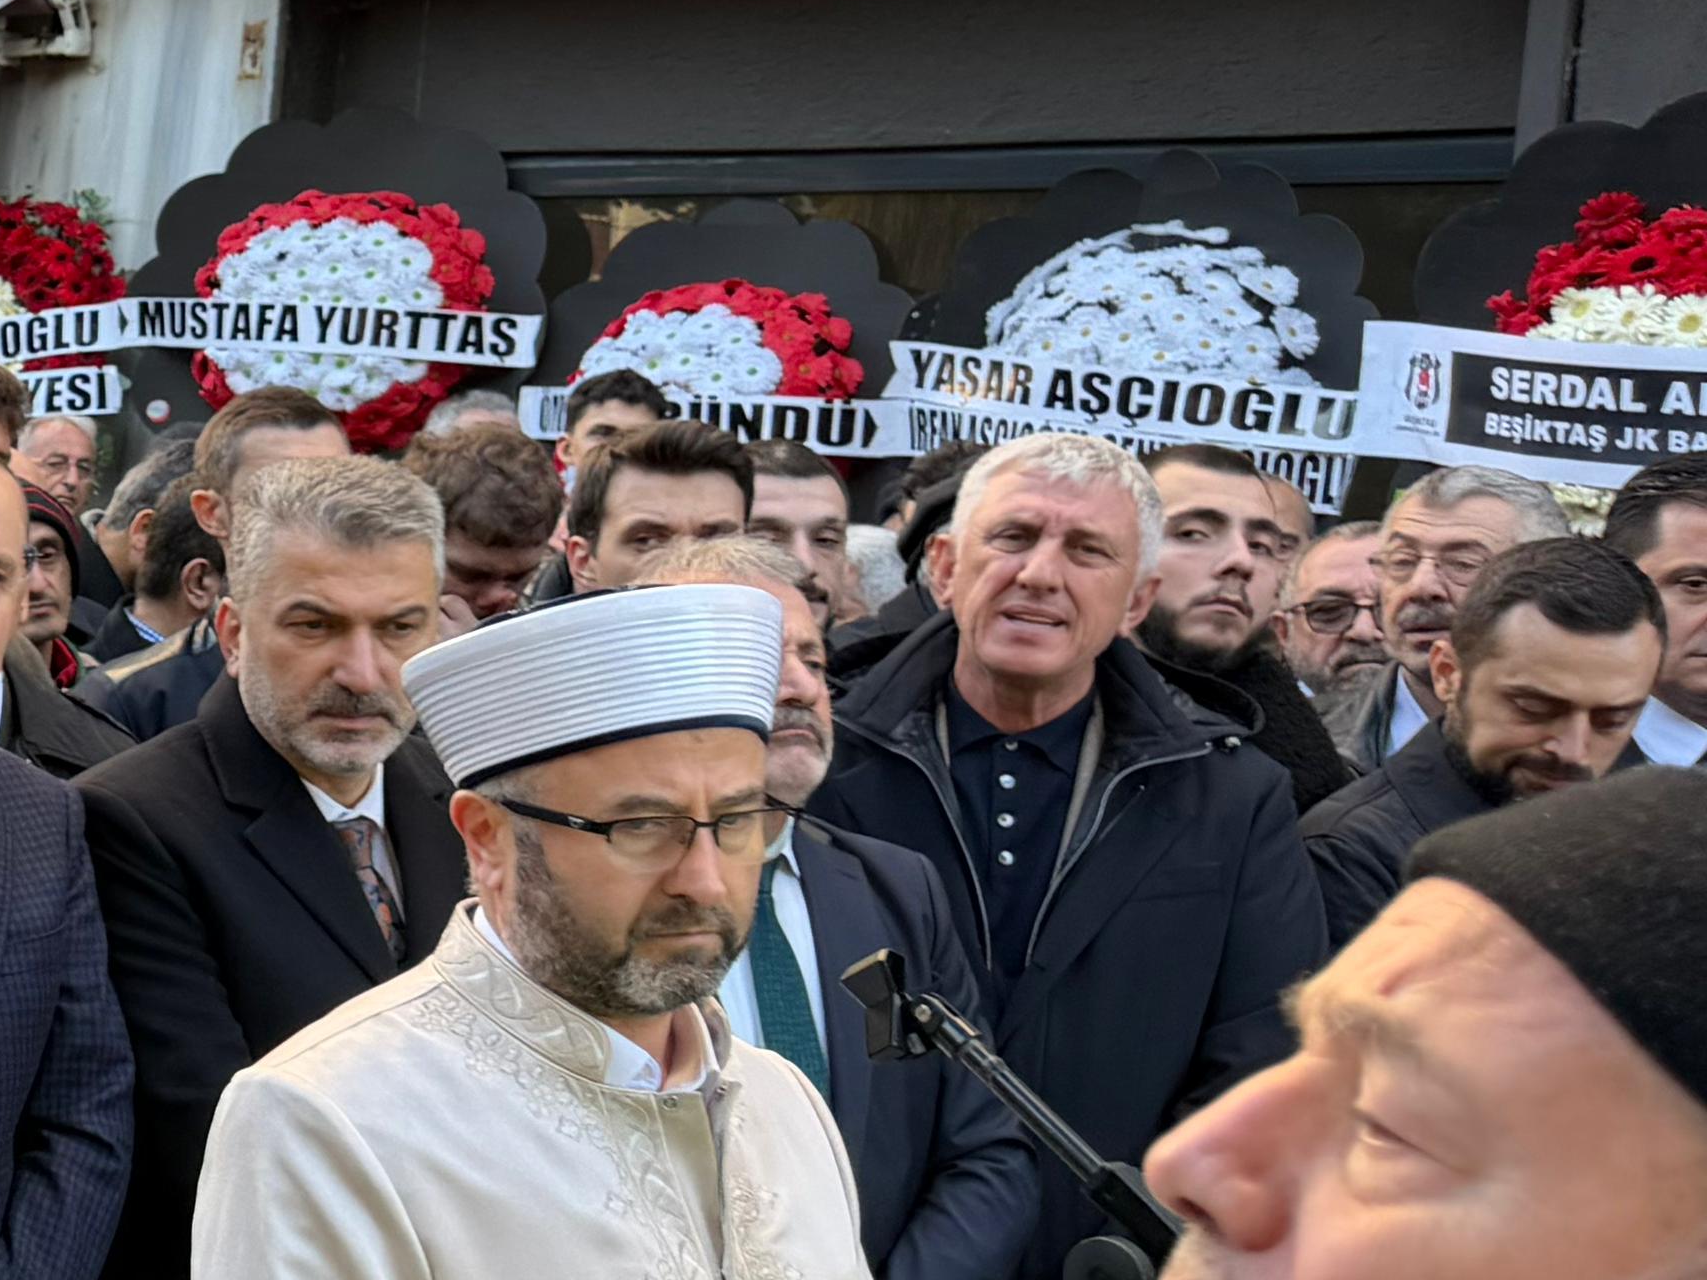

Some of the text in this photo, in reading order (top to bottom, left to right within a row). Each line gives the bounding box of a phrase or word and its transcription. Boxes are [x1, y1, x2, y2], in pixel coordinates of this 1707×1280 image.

[138, 301, 518, 363] MUSTAFA YURTTAŞ
[908, 349, 1034, 405] YAŞAR
[1490, 367, 1647, 413] SERDAL
[1484, 412, 1608, 453] BEŞİKTAŞ
[1615, 427, 1659, 451] JK
